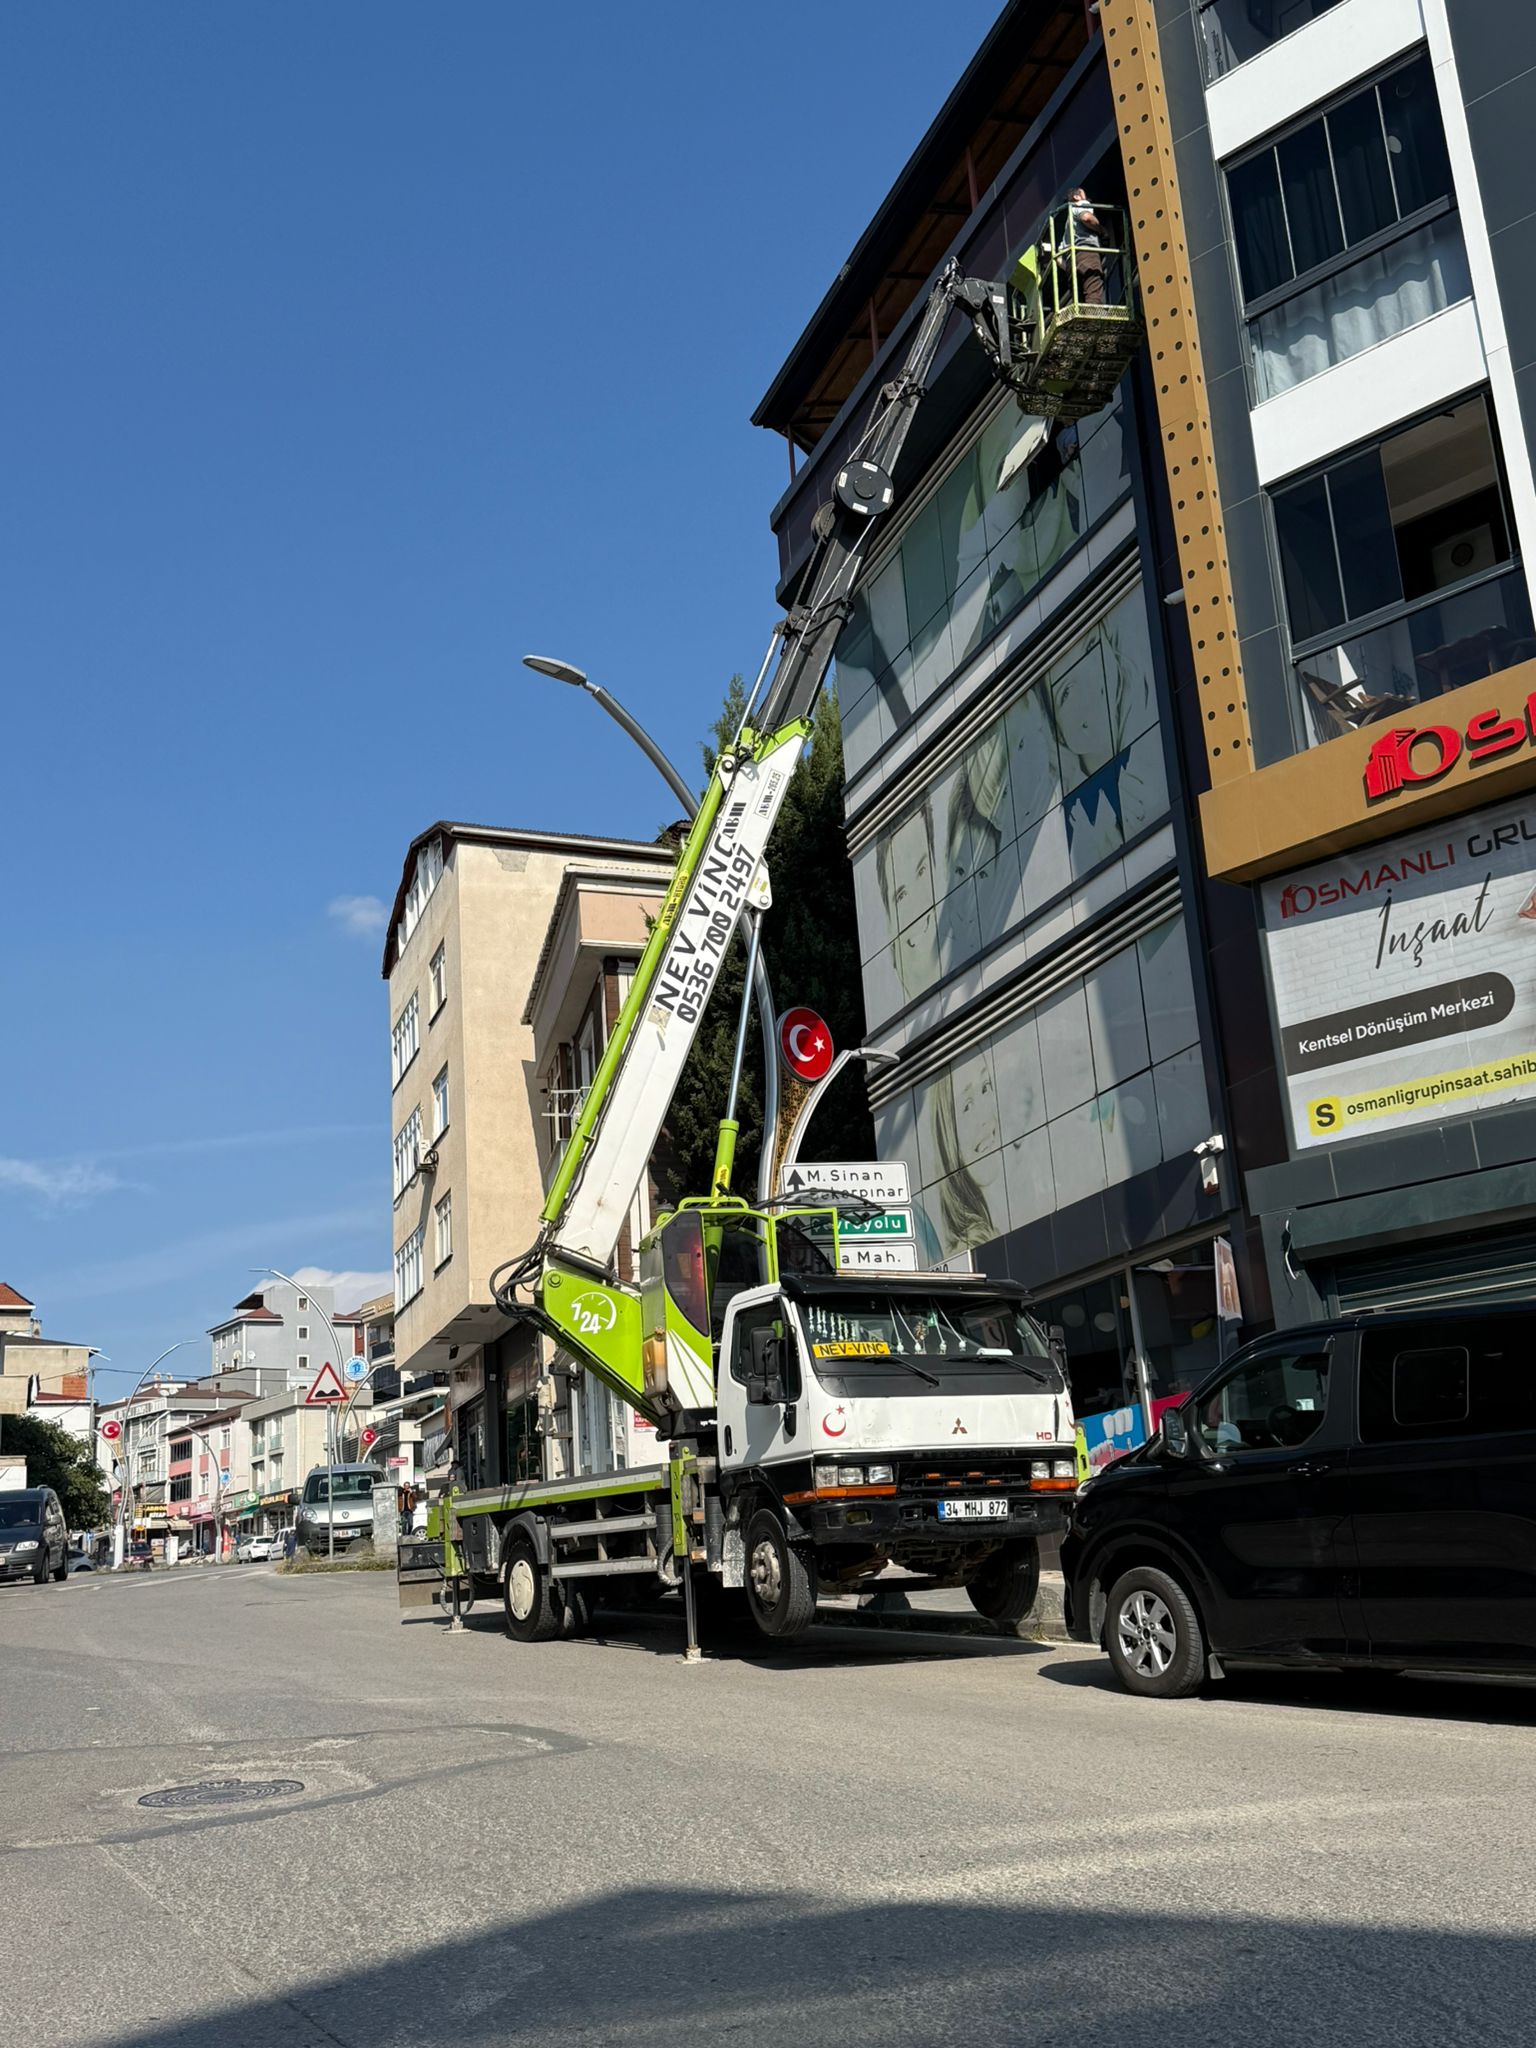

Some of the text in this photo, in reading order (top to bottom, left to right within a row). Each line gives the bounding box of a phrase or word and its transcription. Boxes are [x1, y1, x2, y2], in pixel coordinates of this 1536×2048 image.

[1393, 691, 1536, 783] OS
[1291, 843, 1456, 914] OSMANLI
[677, 843, 757, 1024] 0536 700 2497
[1375, 871, 1495, 970] İnşaat
[654, 930, 698, 1012] NEV
[1299, 990, 1495, 1055] Kentsel Dönüşüm Merkezi
[1315, 1103, 1336, 1128] S
[857, 1250, 901, 1264] Mah.
[580, 1310, 602, 1335] 24
[1036, 1431, 1052, 1441] HD
[945, 1500, 1007, 1517] 34 MHJ 872
